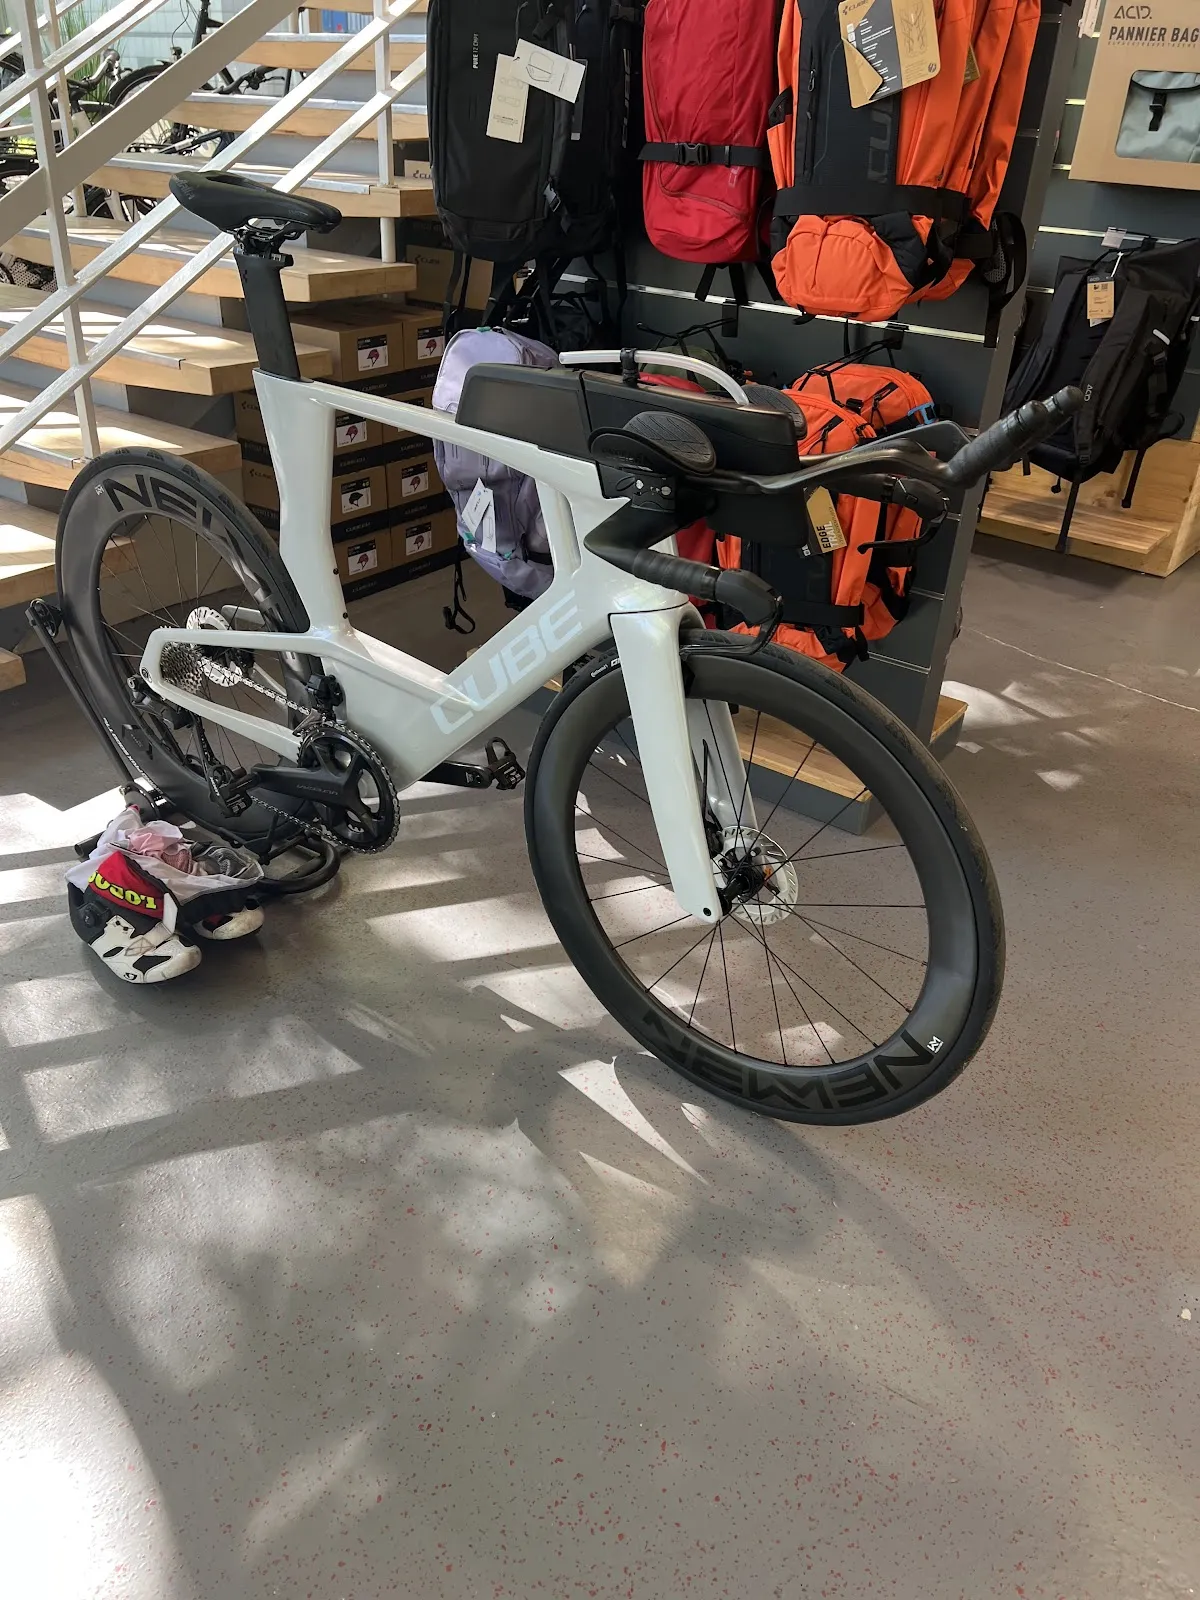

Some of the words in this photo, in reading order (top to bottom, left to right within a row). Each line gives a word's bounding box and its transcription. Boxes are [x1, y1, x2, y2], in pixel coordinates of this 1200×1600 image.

[1109, 26, 1167, 40] PANNIER
[816, 525, 832, 549] EDGE
[824, 520, 839, 548] TRAIL
[429, 588, 583, 735] CUBE
